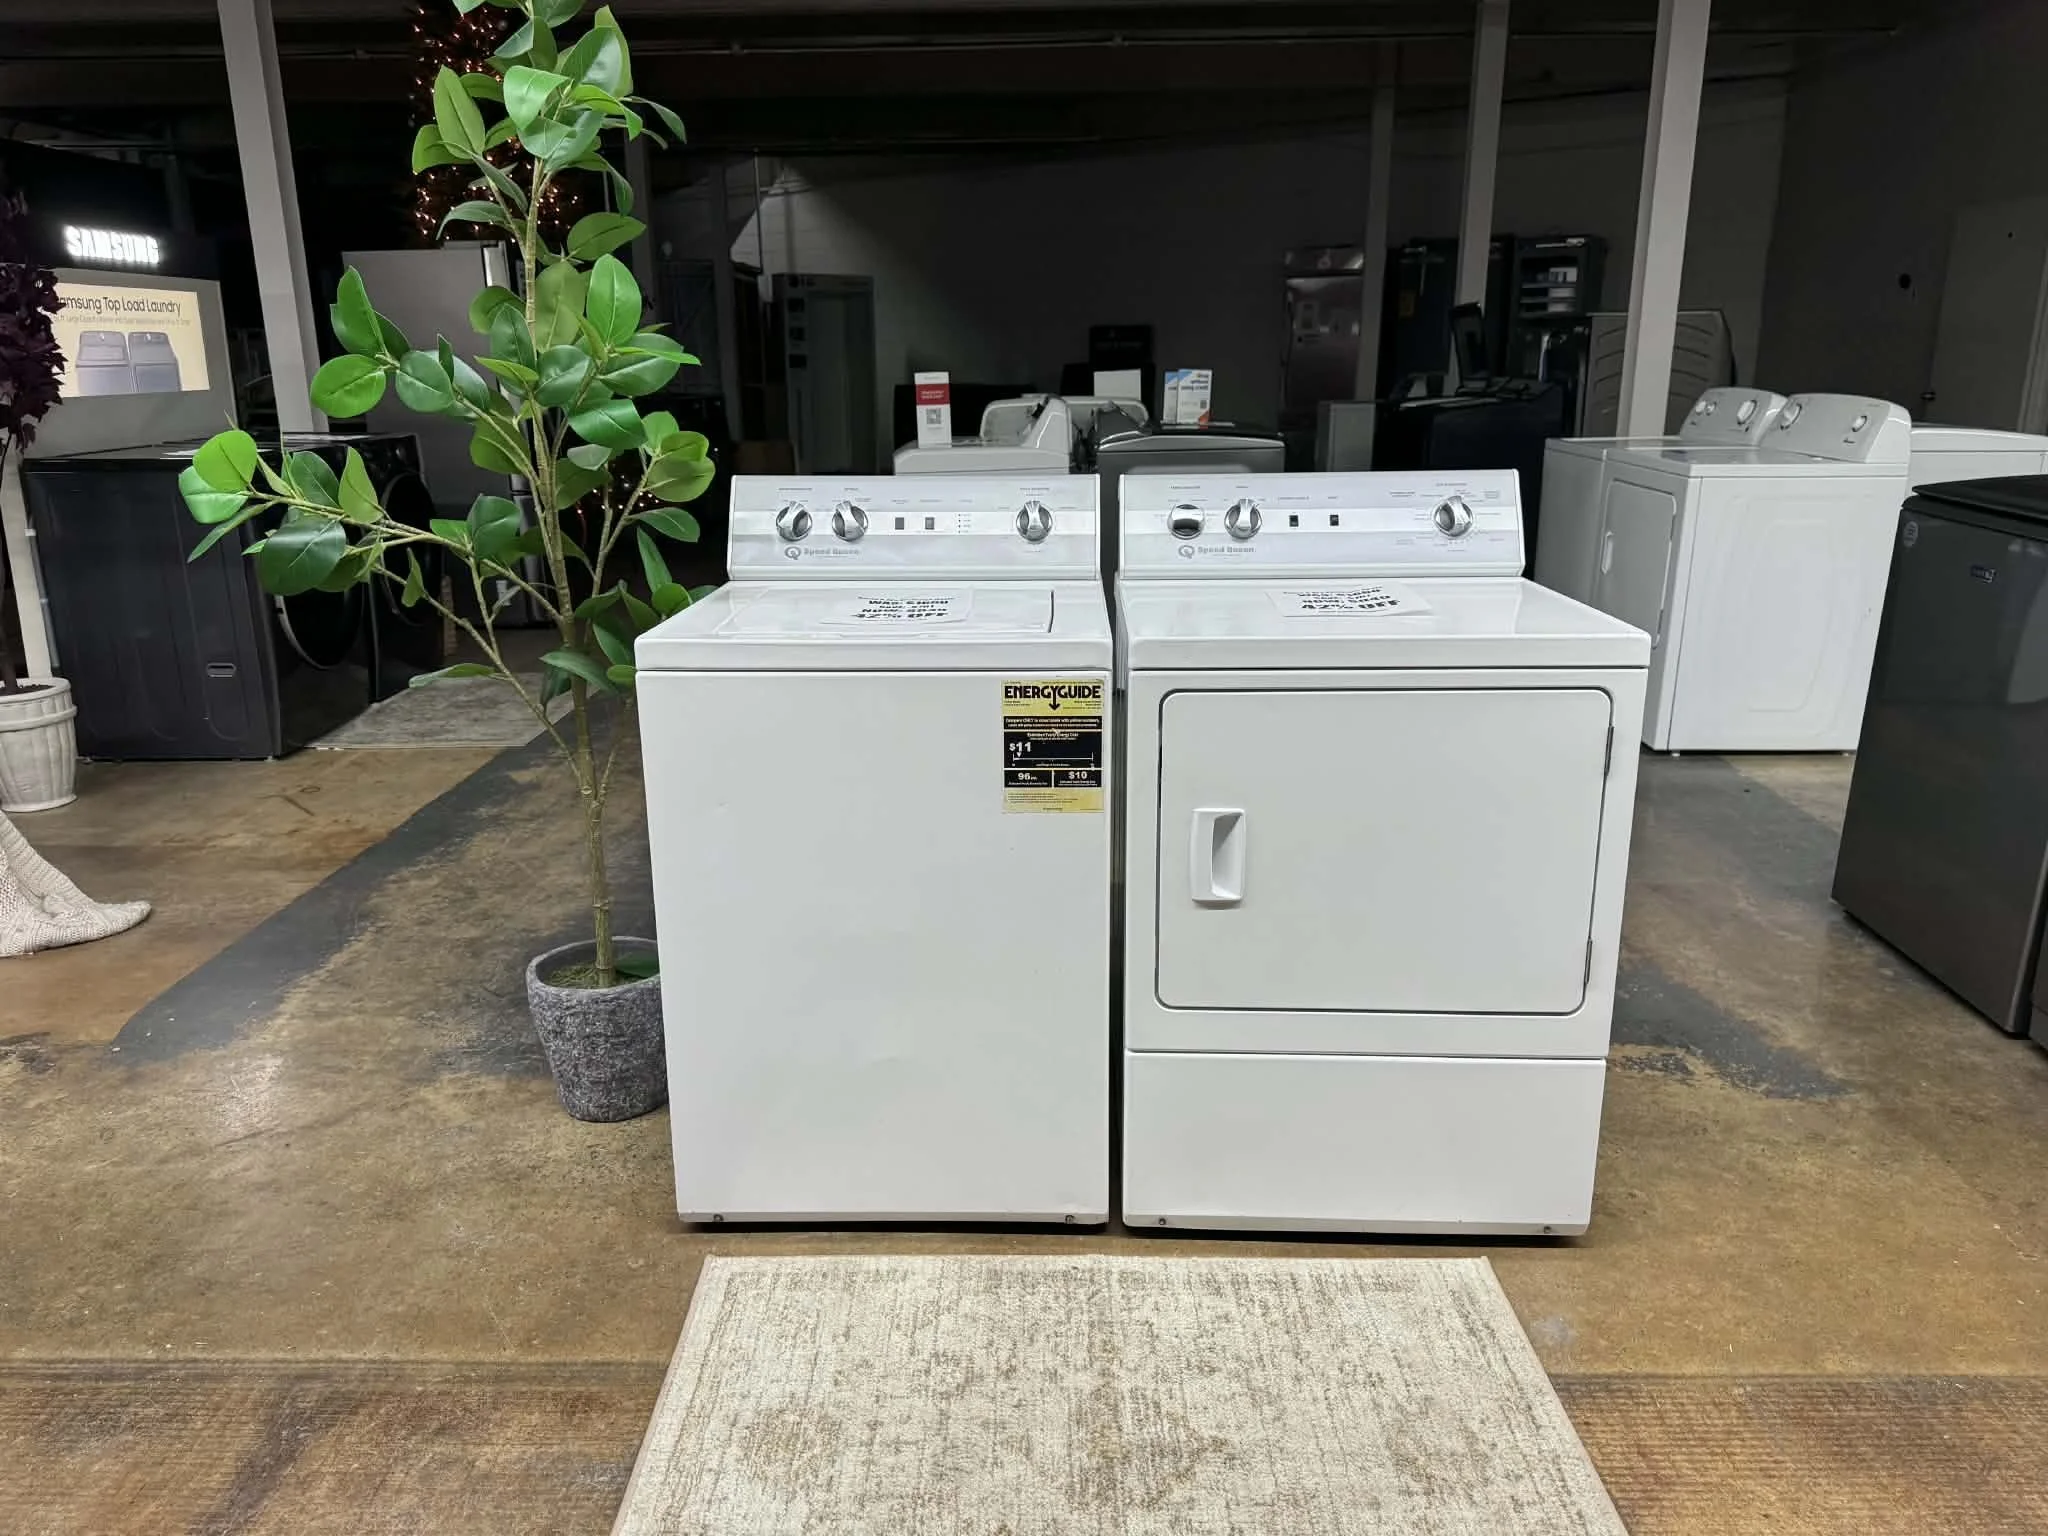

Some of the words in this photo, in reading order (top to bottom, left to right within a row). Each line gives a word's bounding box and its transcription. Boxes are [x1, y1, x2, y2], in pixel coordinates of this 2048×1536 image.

[65, 224, 160, 264] SAMSUNG
[58, 296, 102, 314] amsung
[103, 296, 120, 315] Top
[121, 296, 145, 313] Load
[147, 298, 181, 317] Laundry
[1003, 685, 1102, 699] ENERGYGUIDE
[1008, 741, 1032, 752] $11
[1068, 770, 1088, 780] $10
